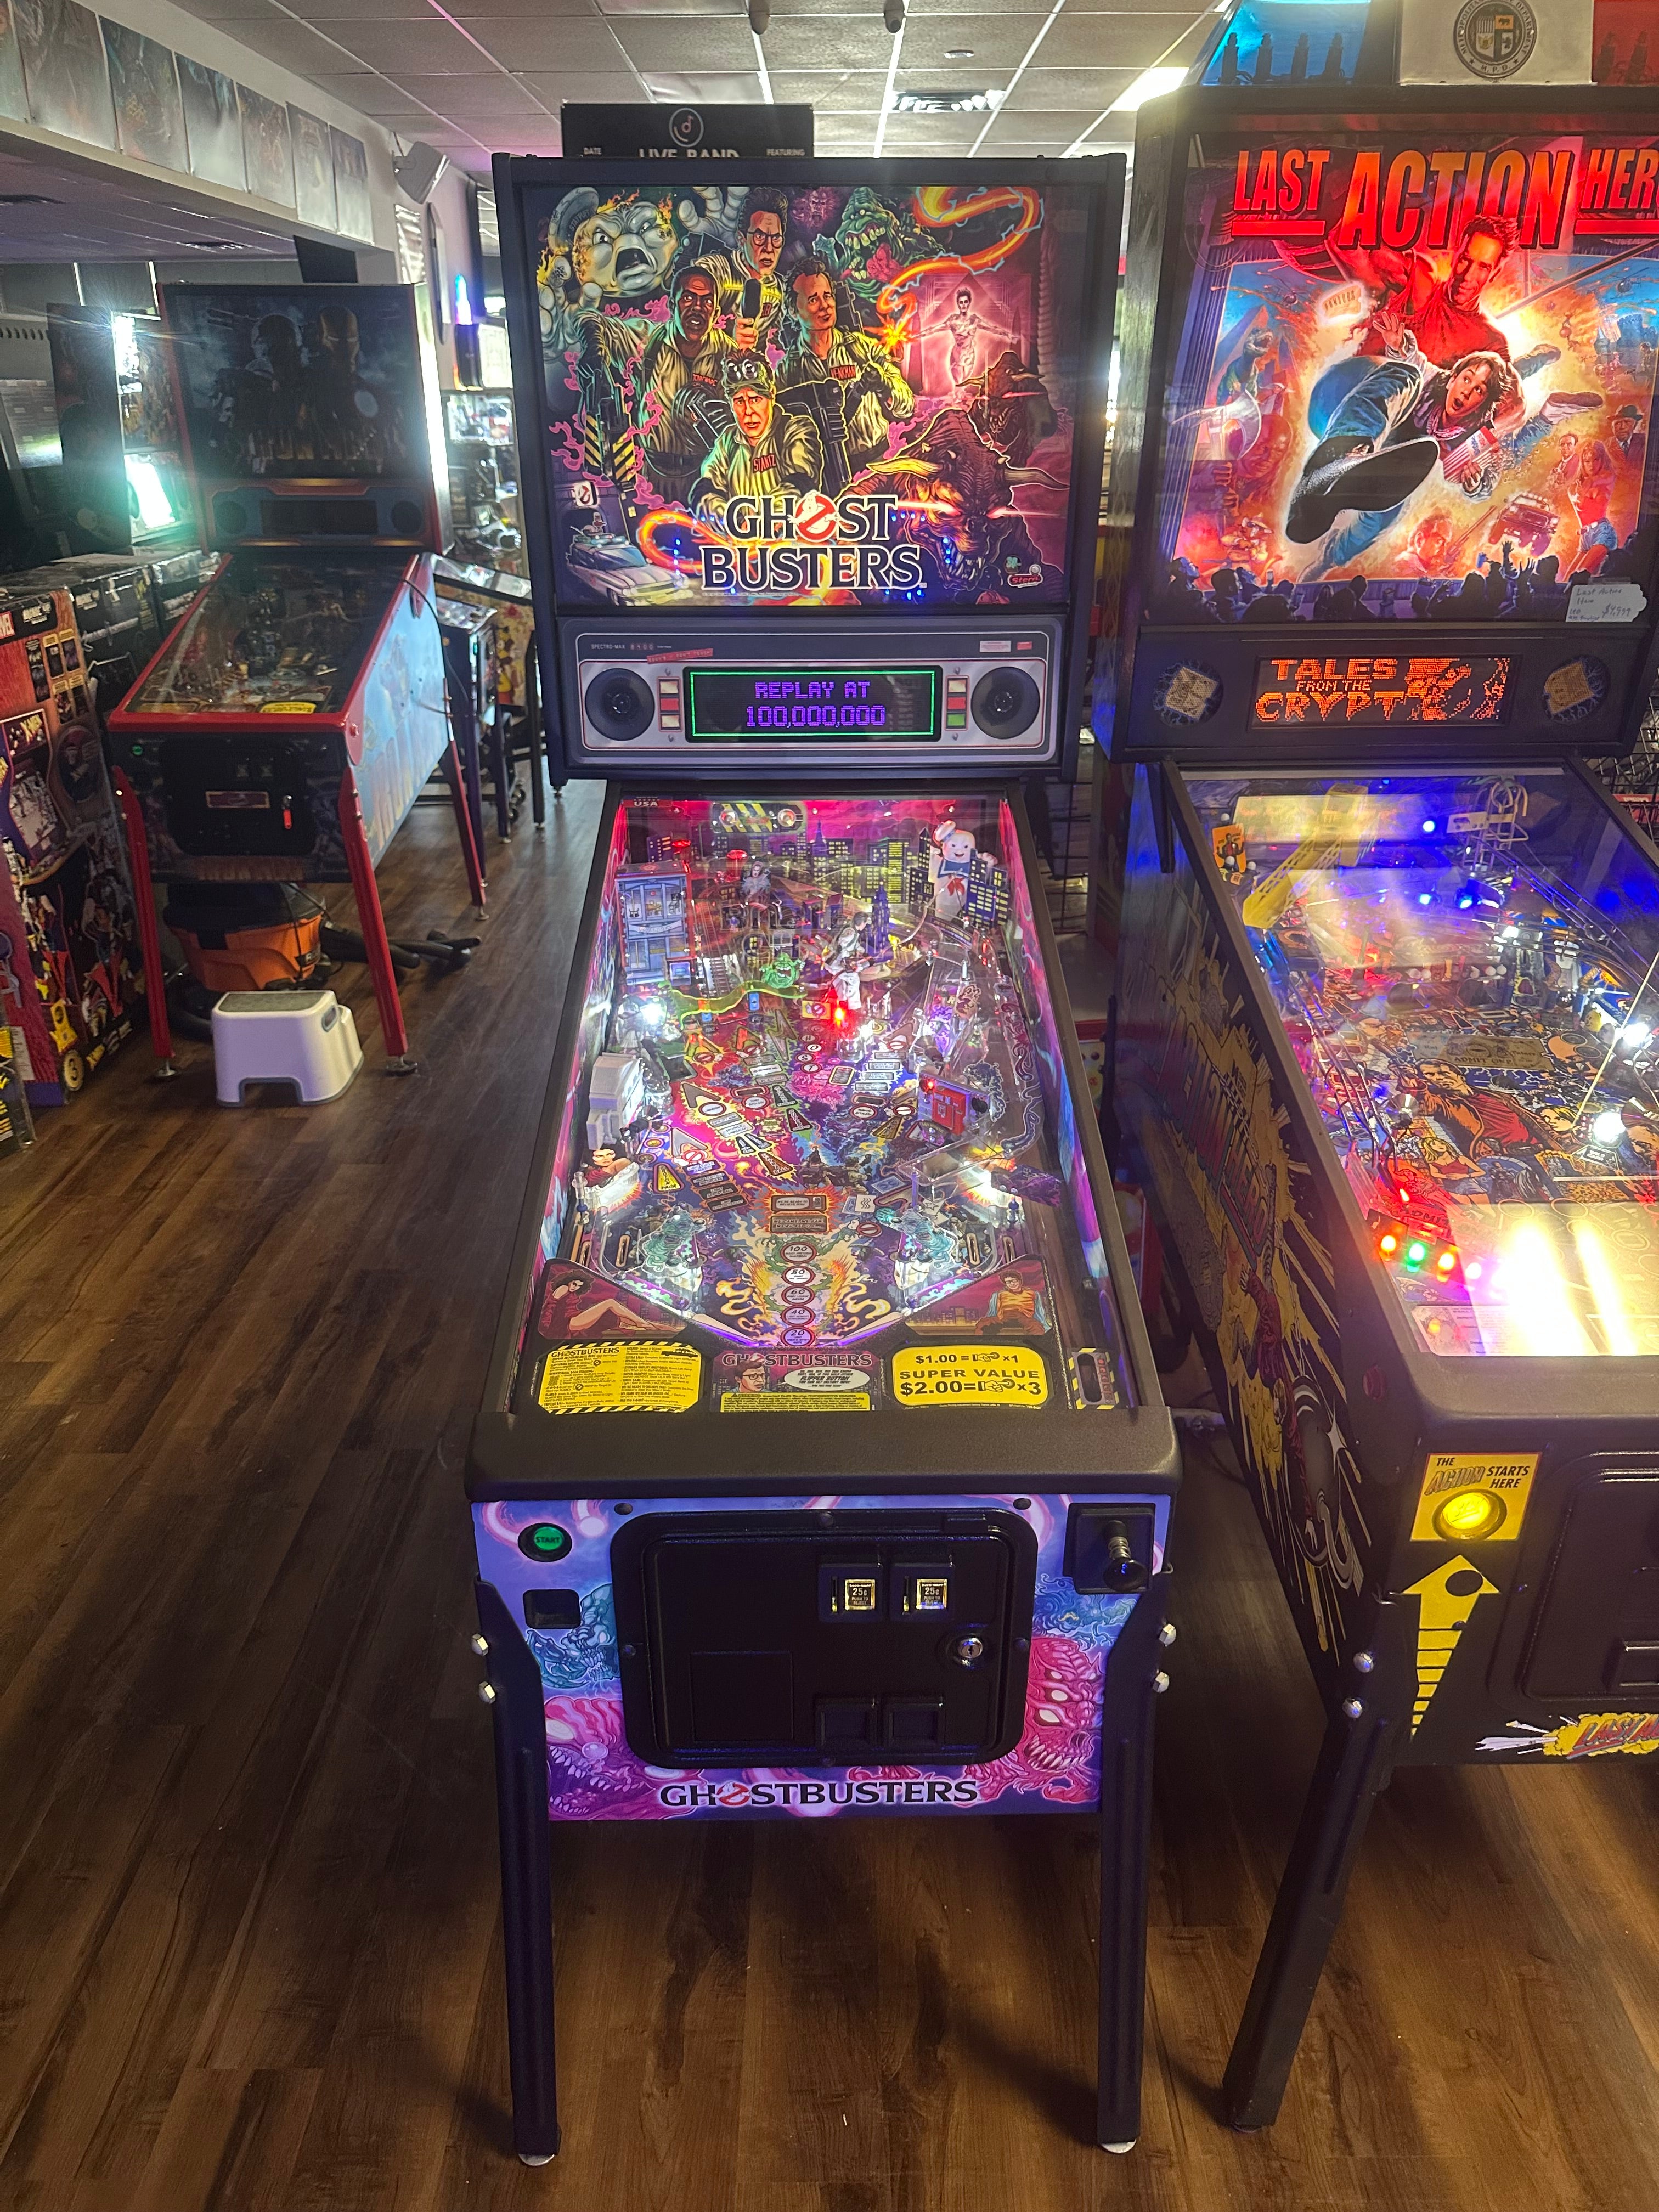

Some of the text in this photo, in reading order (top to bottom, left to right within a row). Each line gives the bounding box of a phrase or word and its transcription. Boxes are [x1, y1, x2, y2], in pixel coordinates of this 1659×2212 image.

[1481, 64, 1489, 72] M.
[1502, 64, 1510, 72] D.
[584, 147, 602, 156] DATE
[639, 148, 739, 158] LIVE BAND
[766, 148, 805, 156] FEATURING
[1233, 149, 1330, 213] LAST
[1338, 149, 1576, 251] ACTION
[830, 364, 857, 379] VENKMAN
[753, 453, 776, 472] STANTZ
[724, 490, 899, 543] GHOST
[699, 544, 922, 591] BUSTERS
[1011, 575, 1040, 584] Stern
[1271, 658, 1398, 680] TALES
[755, 681, 871, 699] REPLAY AT
[1296, 680, 1372, 691] FROM THE
[1255, 691, 1407, 721] CRYPT
[746, 705, 885, 729] 100,000,000
[1454, 1056, 1488, 1064] ADMIT
[551, 1347, 620, 1358] GHOSTBUSTERS
[721, 1352, 872, 1367] GHOSTBUSTERS
[915, 1354, 957, 1364] $1.00
[1003, 1355, 1019, 1363] x1
[899, 1369, 1040, 1379] SUPER VALUE
[900, 1381, 1041, 1397] $2.00= x3
[1436, 1457, 1455, 1466] THE
[1424, 1465, 1530, 1496] ACTION STARTS
[1489, 1478, 1522, 1488] HERE
[535, 1535, 562, 1545] START
[853, 1588, 868, 1596] 25¢
[924, 1587, 940, 1595] 25¢
[1572, 1715, 1646, 1751] LAST
[659, 1779, 979, 1807] GHOSTBUSTERS
